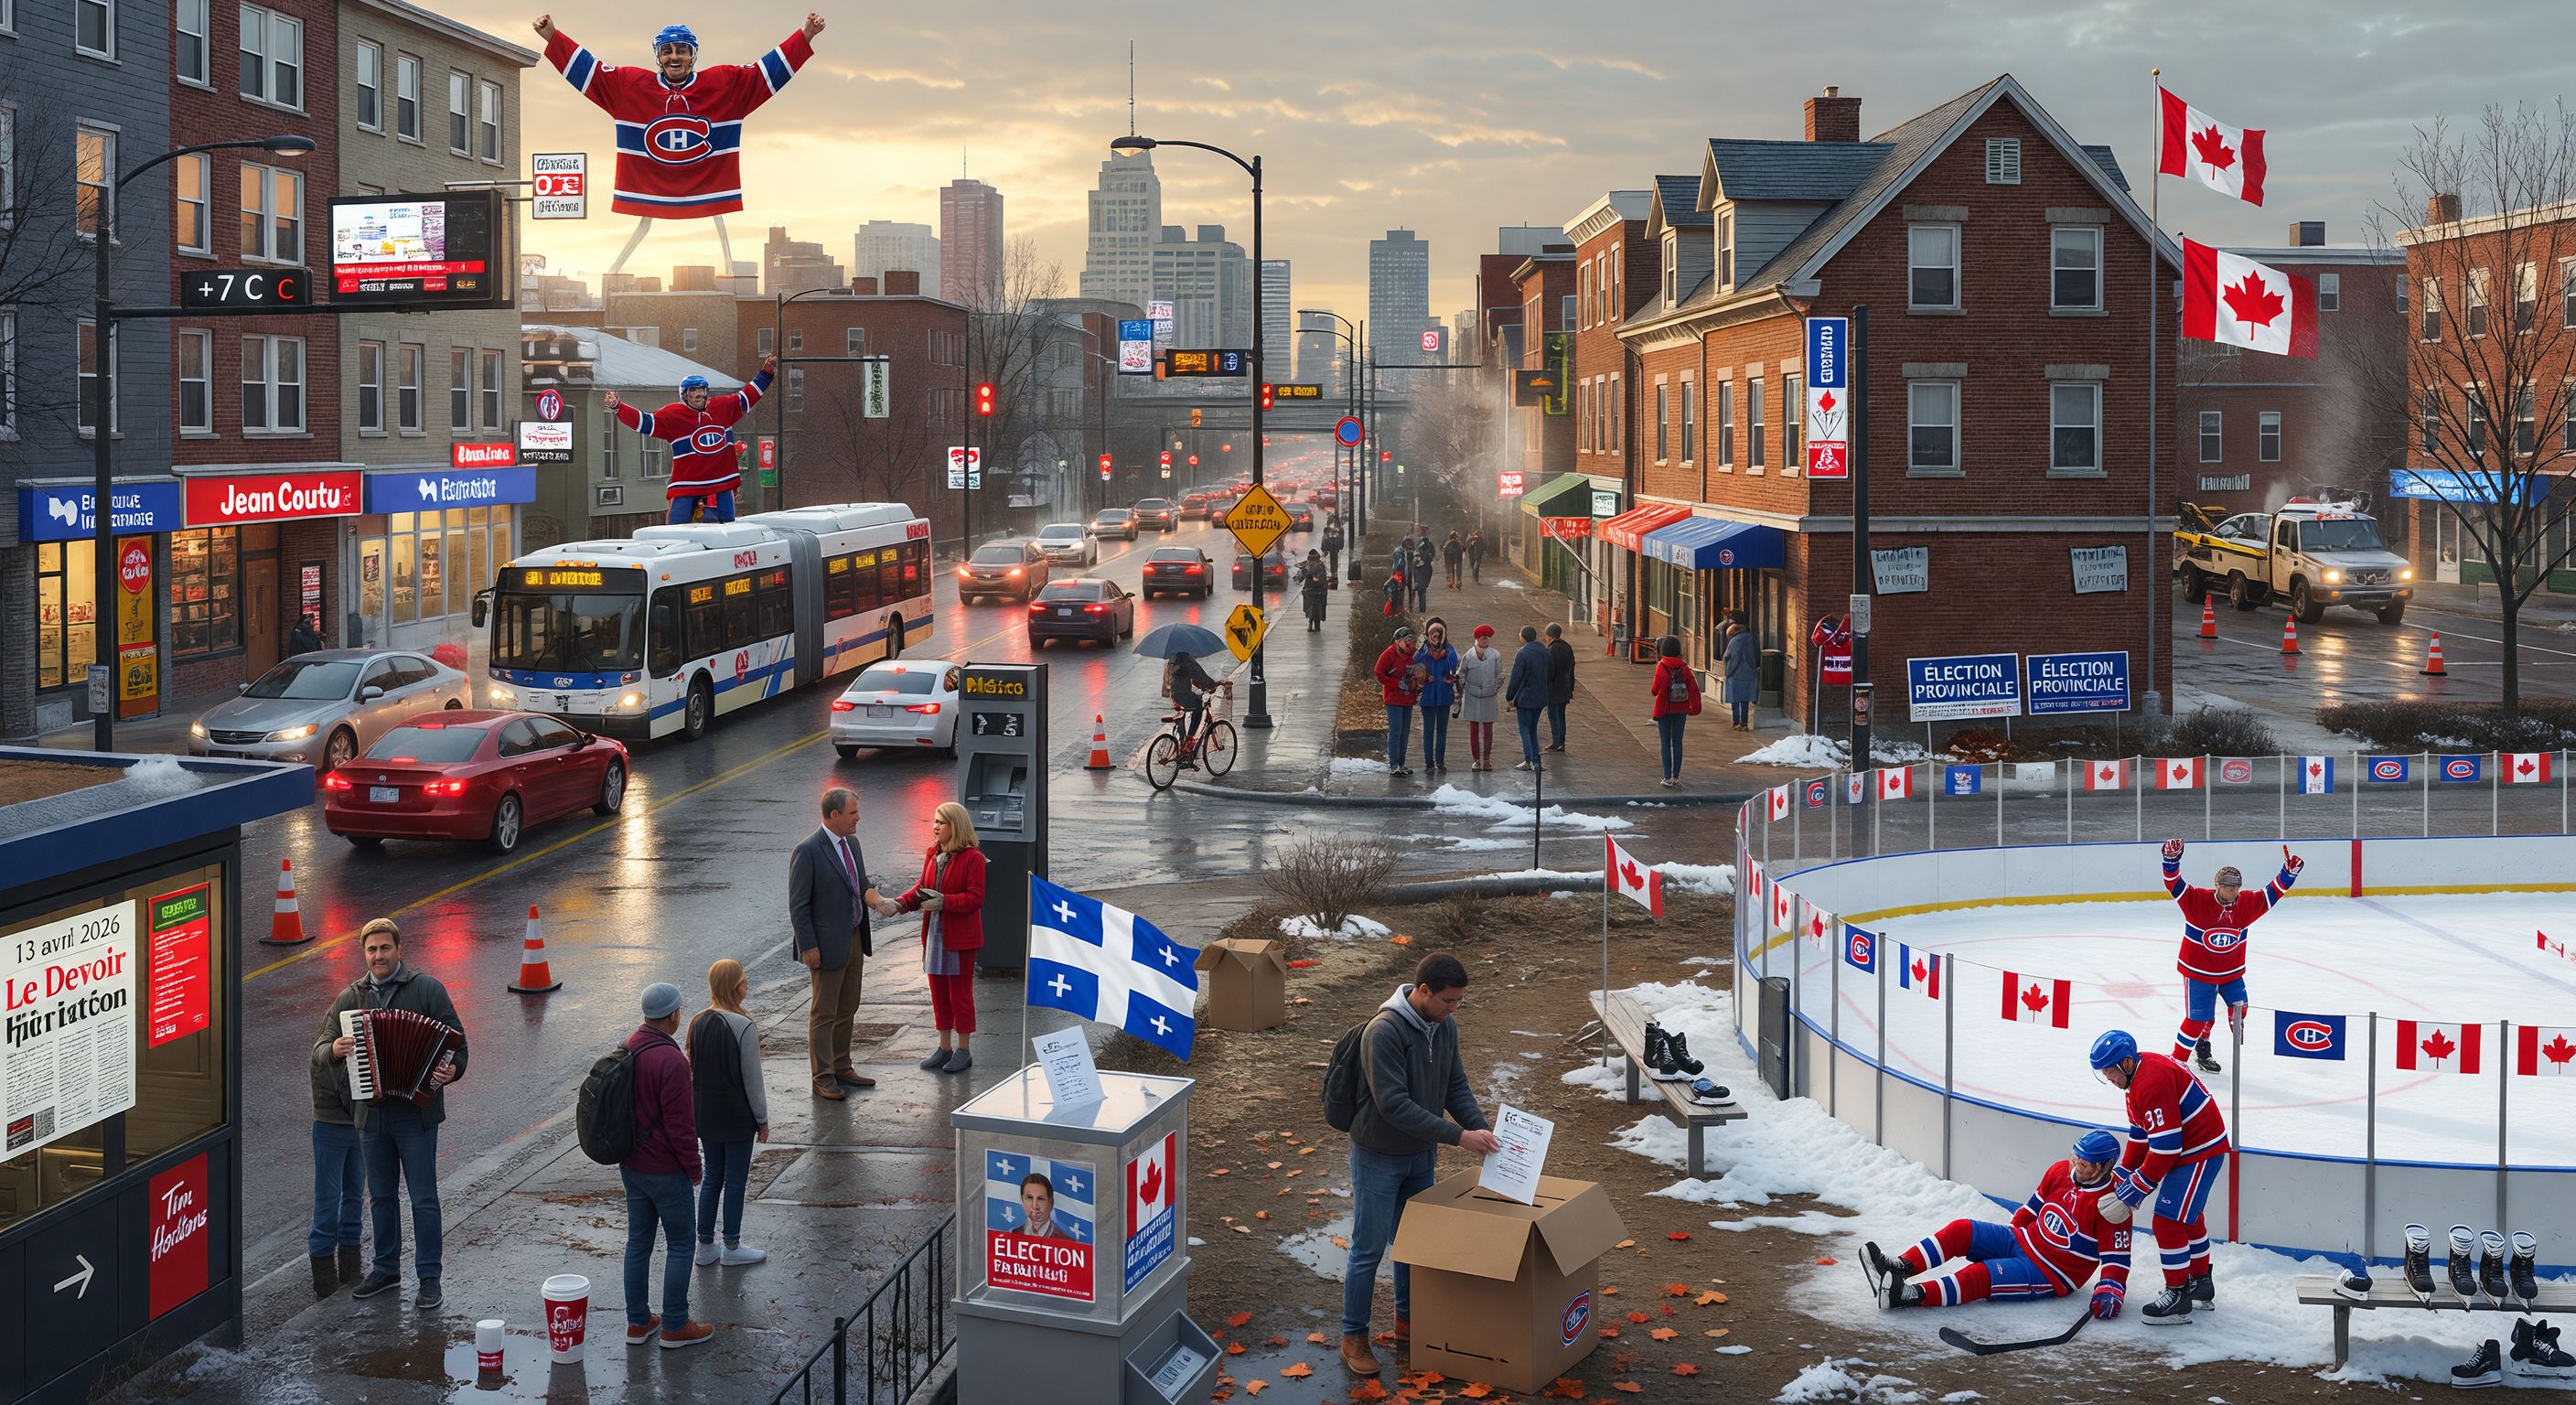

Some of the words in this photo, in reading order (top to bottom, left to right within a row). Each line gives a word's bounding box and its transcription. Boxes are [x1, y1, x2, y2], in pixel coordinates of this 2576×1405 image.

[244, 274, 263, 301] C
[220, 484, 274, 515] Jean
[277, 481, 340, 509] Coutu
[1925, 662, 2002, 681] ÉLECTION
[2042, 659, 2113, 678] ÉLECTION
[1916, 681, 2014, 699] PROVINCIALE
[2033, 677, 2124, 693] PROVINCIALE
[16, 940, 35, 964] 13
[80, 914, 121, 944] 2026
[5, 977, 38, 1013] Le
[45, 946, 127, 1000] Devoir
[994, 1234, 1085, 1269] ÉLECTION
